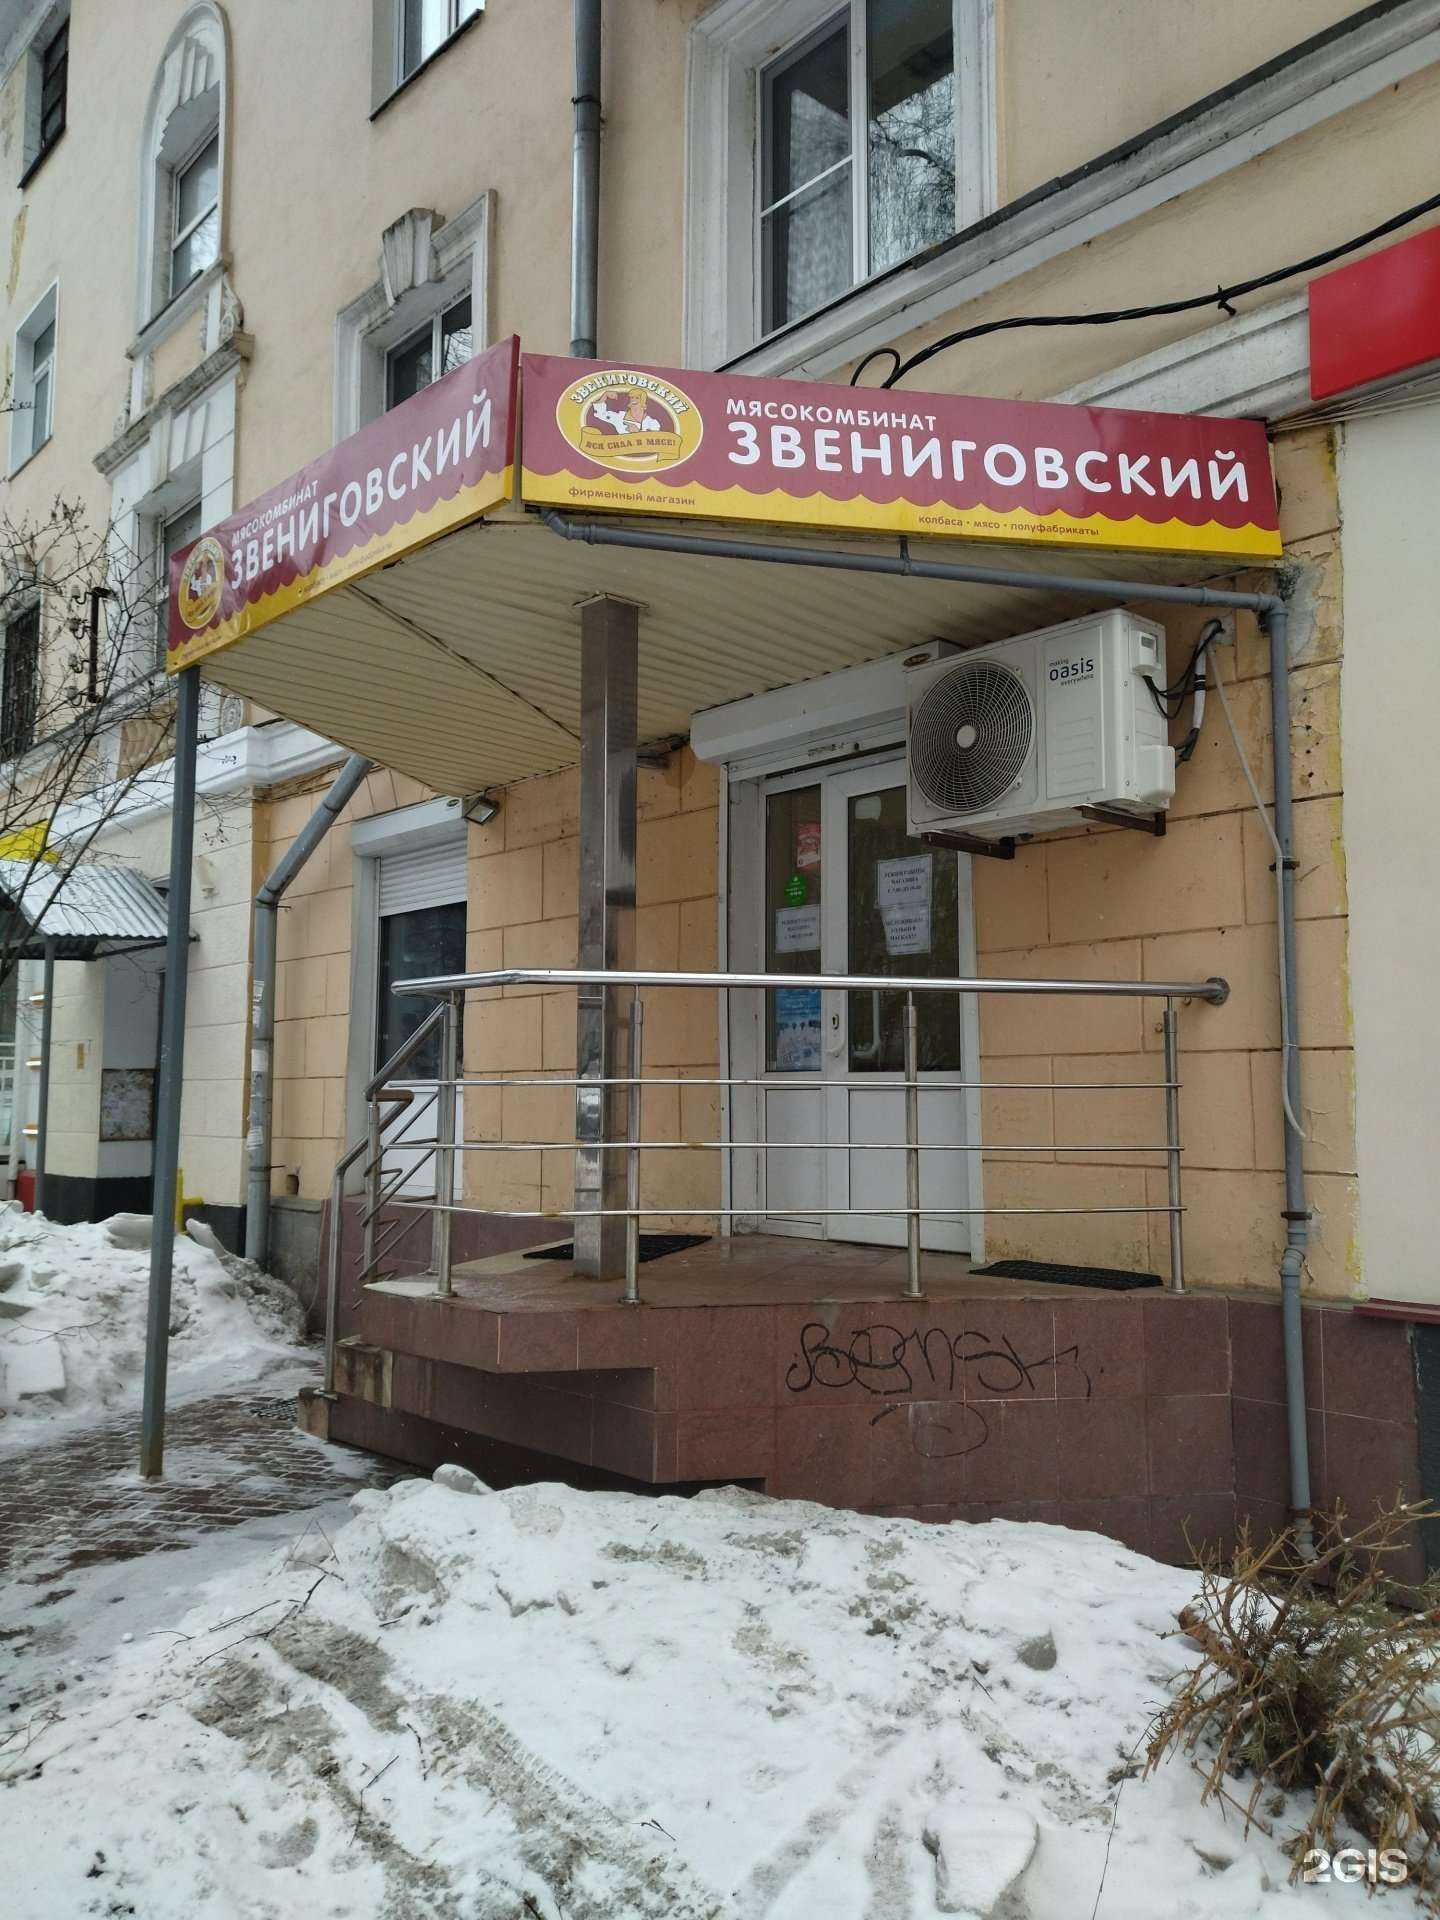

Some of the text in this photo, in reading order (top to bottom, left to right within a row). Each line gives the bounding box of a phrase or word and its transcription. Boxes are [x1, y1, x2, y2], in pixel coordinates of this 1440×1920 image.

[726, 398, 937, 432] МЯСОКОМБИНАТ
[727, 421, 1249, 502] ЗВЕНИГОВСКИЙ
[231, 388, 491, 590] ЗВЕНИГОВСКИЙ
[568, 486, 696, 506] фирменный магазин
[231, 479, 318, 547] МЯСОКОМБИНАТ
[918, 515, 1100, 536] колбаса мясо полуфабрикаты
[1049, 657, 1094, 681] oasis
